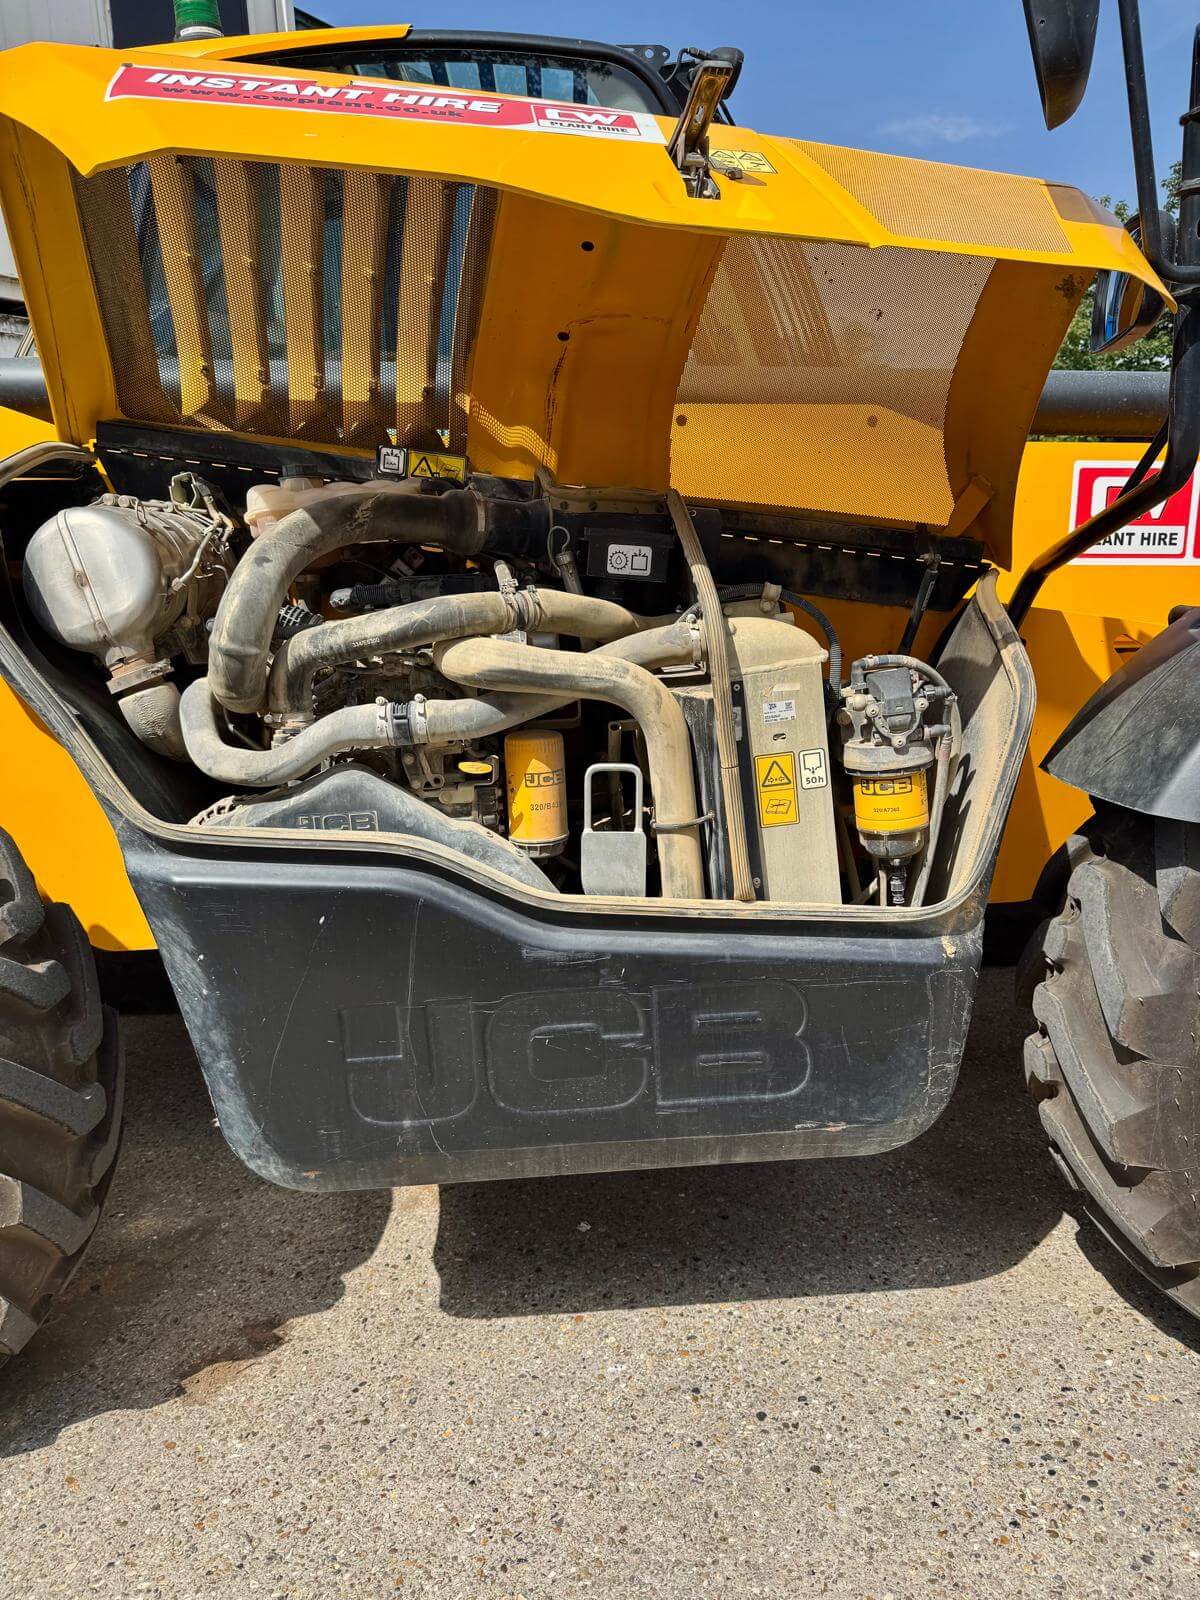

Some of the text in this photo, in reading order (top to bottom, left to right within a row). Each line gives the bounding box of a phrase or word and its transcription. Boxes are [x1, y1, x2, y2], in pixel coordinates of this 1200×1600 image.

[145, 73, 504, 113] INSTANT HIRE
[162, 87, 465, 117] www.cwplant.co.uk
[545, 109, 620, 125] CW
[549, 121, 629, 133] PLANT HIRE
[1140, 532, 1178, 546] HIRE
[525, 769, 564, 787] JCB
[861, 777, 912, 795] JCB
[339, 978, 811, 1125] JCB
